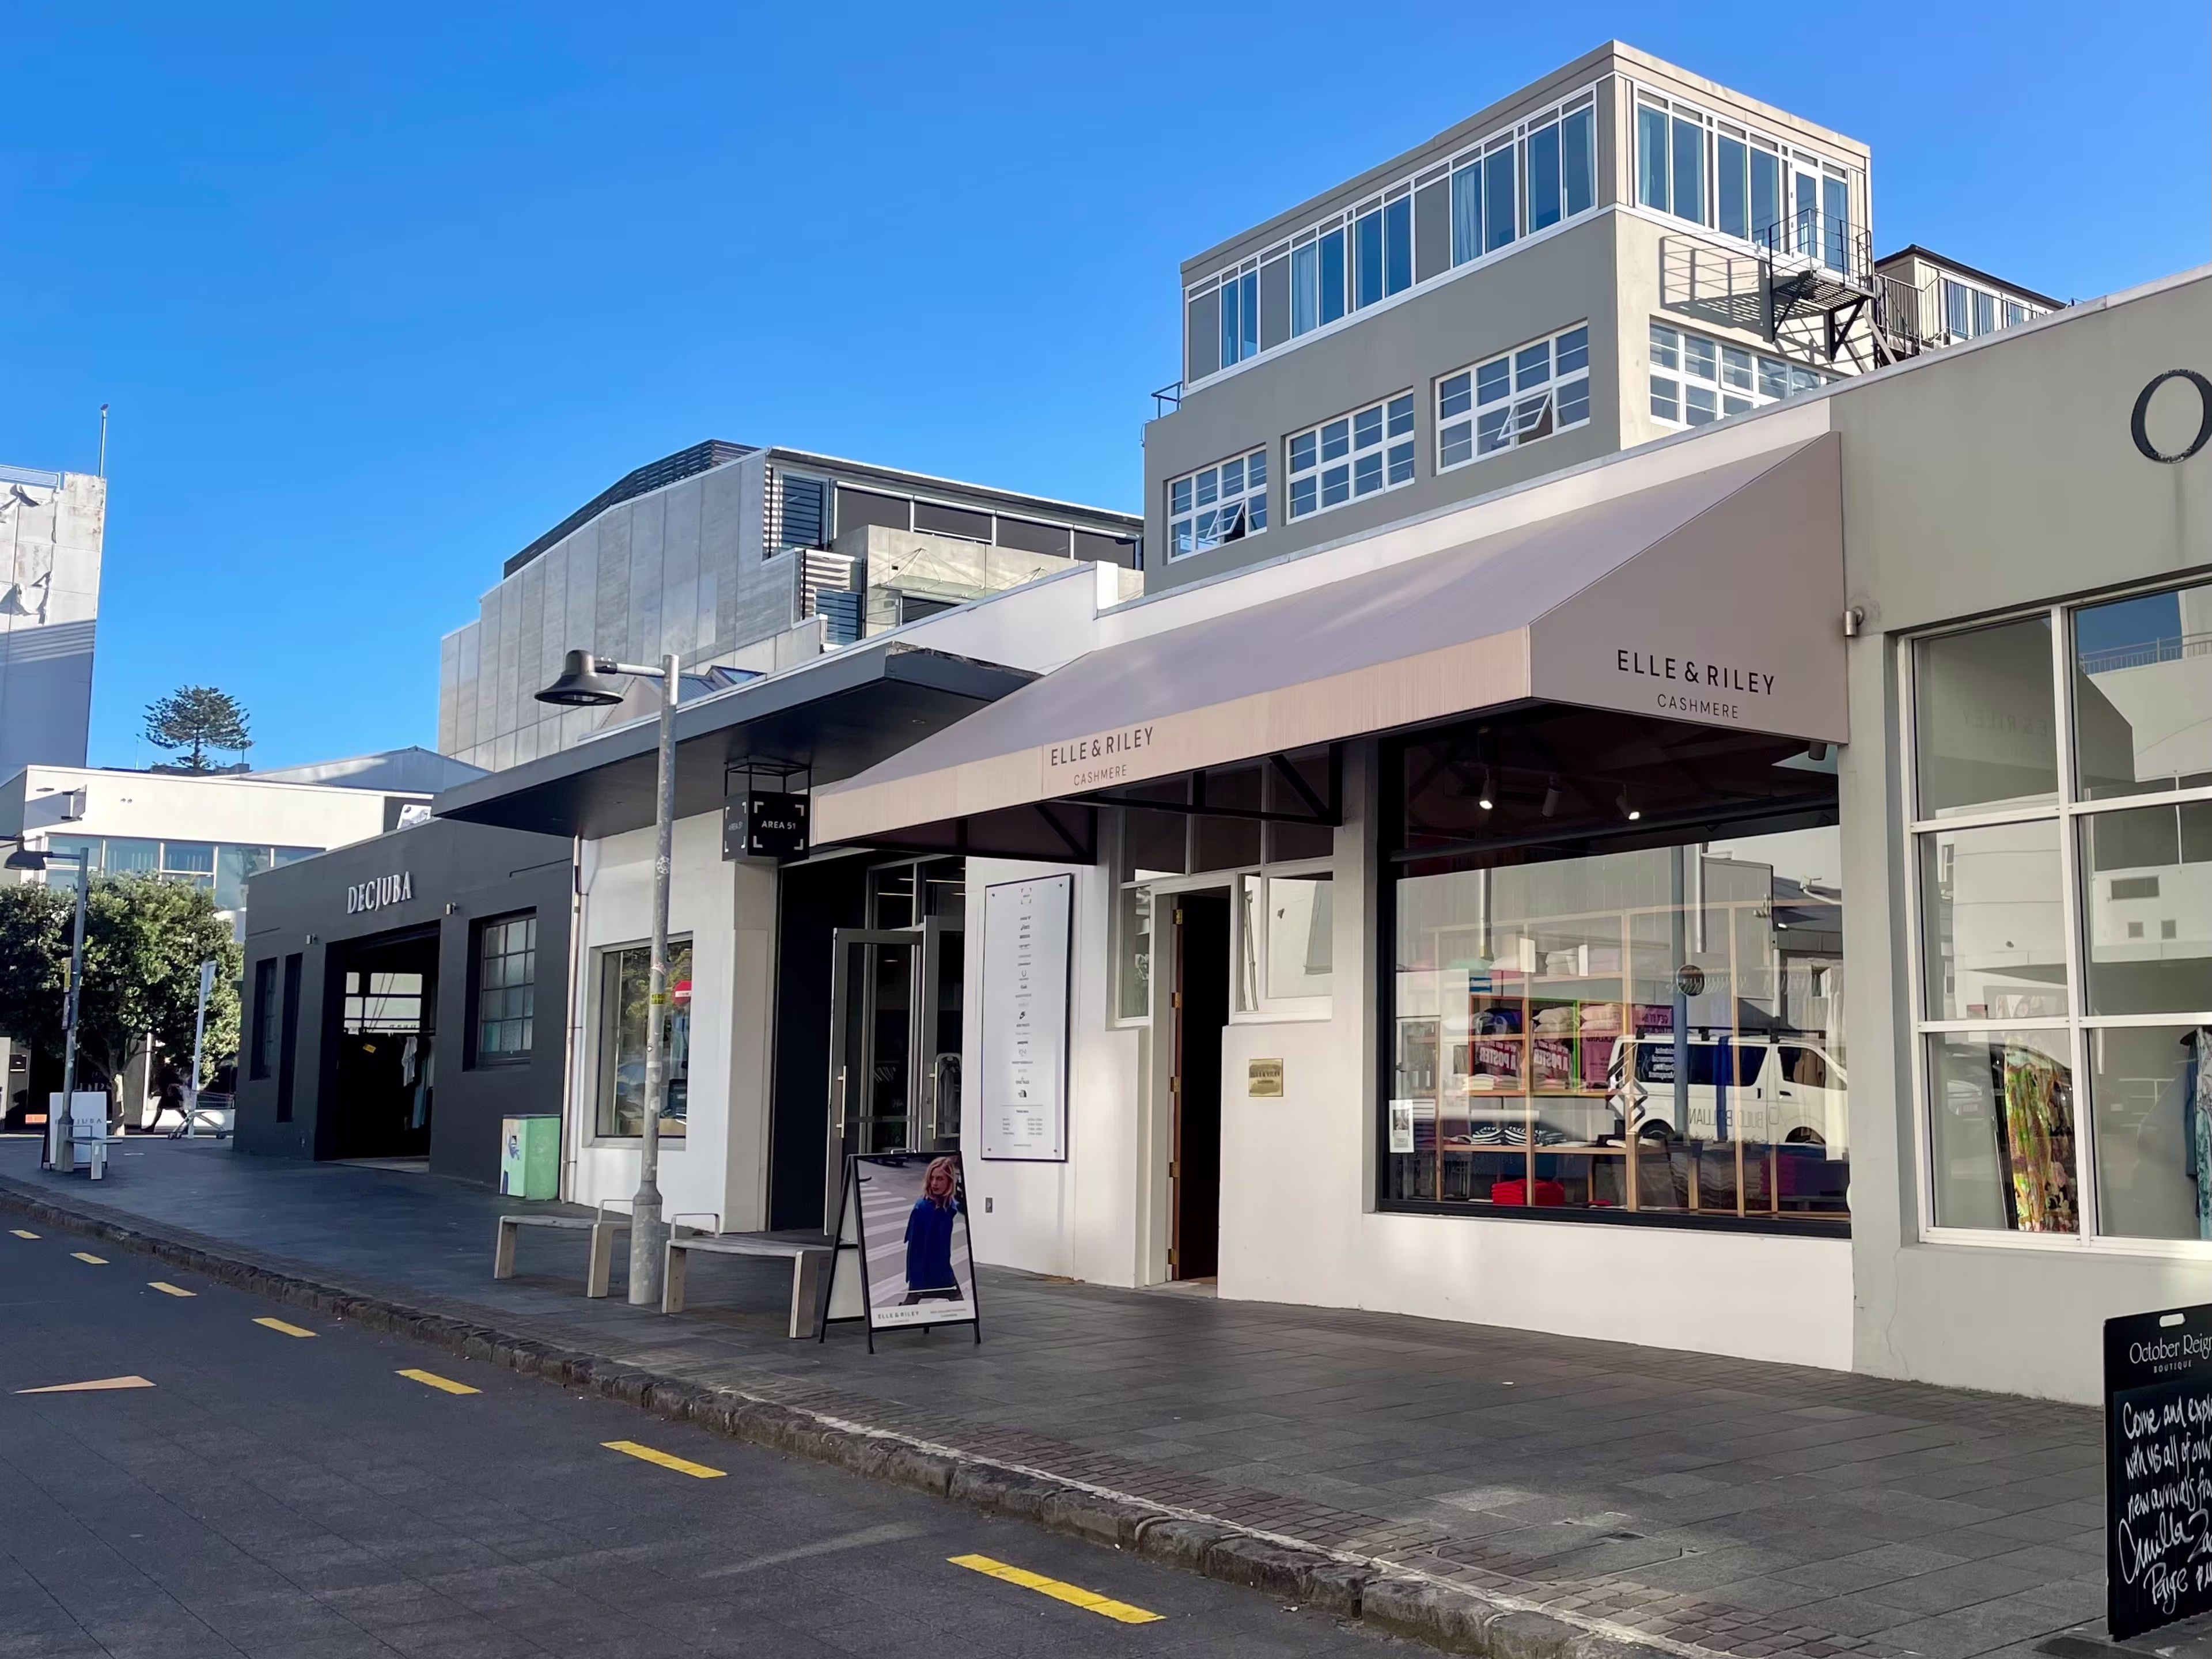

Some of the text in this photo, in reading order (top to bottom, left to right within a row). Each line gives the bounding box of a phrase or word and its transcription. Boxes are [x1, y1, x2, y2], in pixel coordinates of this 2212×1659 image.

[1617, 649, 1775, 695] ELLE & RILEY
[1657, 693, 1739, 719] CASHMERE
[1051, 726, 1153, 767] ELLE & RILEY
[1073, 764, 1127, 786] CASHMERE
[761, 820, 796, 830] AREA 51
[346, 870, 412, 914] DECJUBA
[2129, 1336, 2180, 1365] October
[2153, 1359, 2192, 1374] BOUTIQUE
[2123, 1392, 2212, 1440] Come and expl
[2125, 1442, 2148, 1480] with
[2146, 1442, 2162, 1474] us
[2163, 1433, 2180, 1474] all
[2181, 1431, 2191, 1479] of
[2127, 1467, 2212, 1525] new arrivals fro
[2118, 1510, 2195, 1585] Camilla
[2142, 1561, 2188, 1615] Paige
